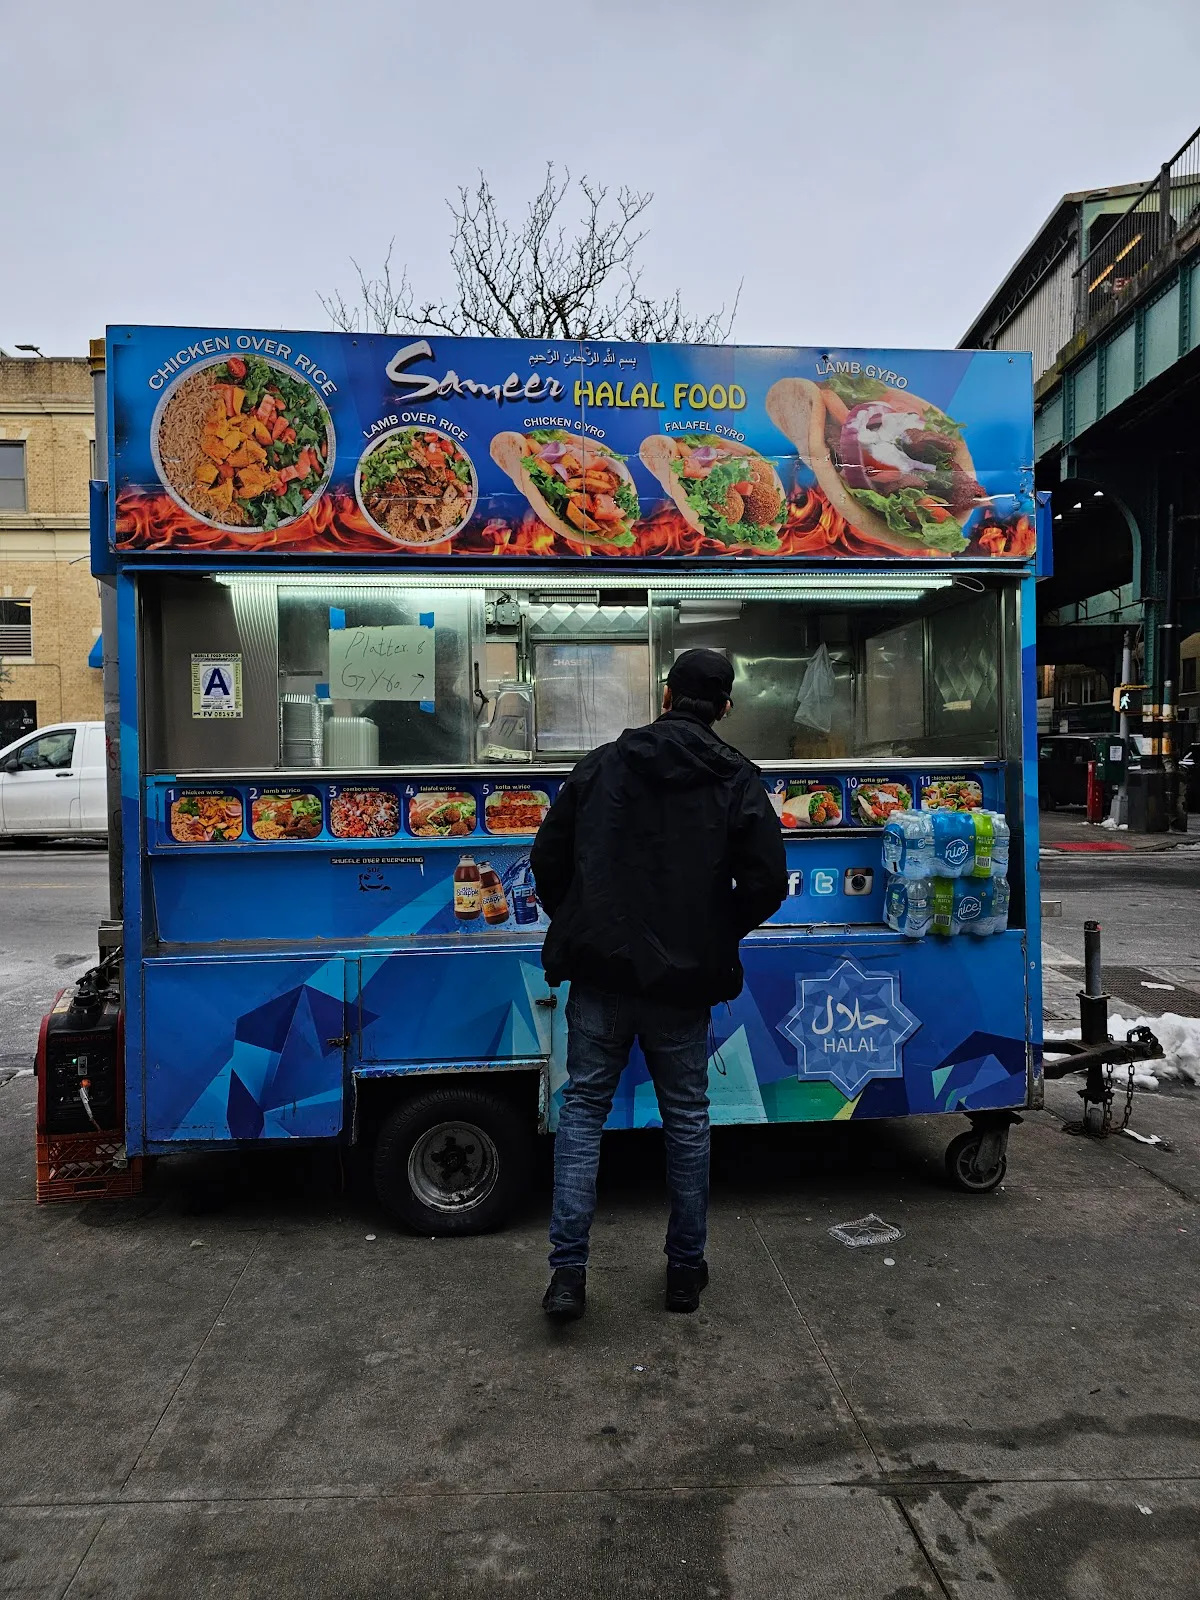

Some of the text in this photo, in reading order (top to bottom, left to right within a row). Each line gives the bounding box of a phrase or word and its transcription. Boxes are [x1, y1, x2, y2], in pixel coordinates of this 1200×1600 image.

[149, 335, 338, 397] CHICKEN OVER RICE
[385, 339, 565, 403] Sameer
[815, 361, 909, 389] LAMB GYRO
[574, 380, 747, 410] HALAL FOOD
[363, 412, 469, 442] LAMB OVER RICE
[523, 416, 606, 439] CHICKEN GYRO
[664, 420, 745, 442] FALAFEL GYRO
[204, 668, 230, 695] A
[482, 784, 490, 795] 5
[774, 779, 785, 794] 9
[846, 777, 858, 788] 10
[919, 775, 931, 786] 11
[168, 789, 175, 801] 1
[249, 787, 258, 799] 2
[329, 786, 337, 797] 3
[405, 785, 415, 796] 4
[811, 994, 890, 1035] حلال
[823, 1036, 879, 1053] HALAL
